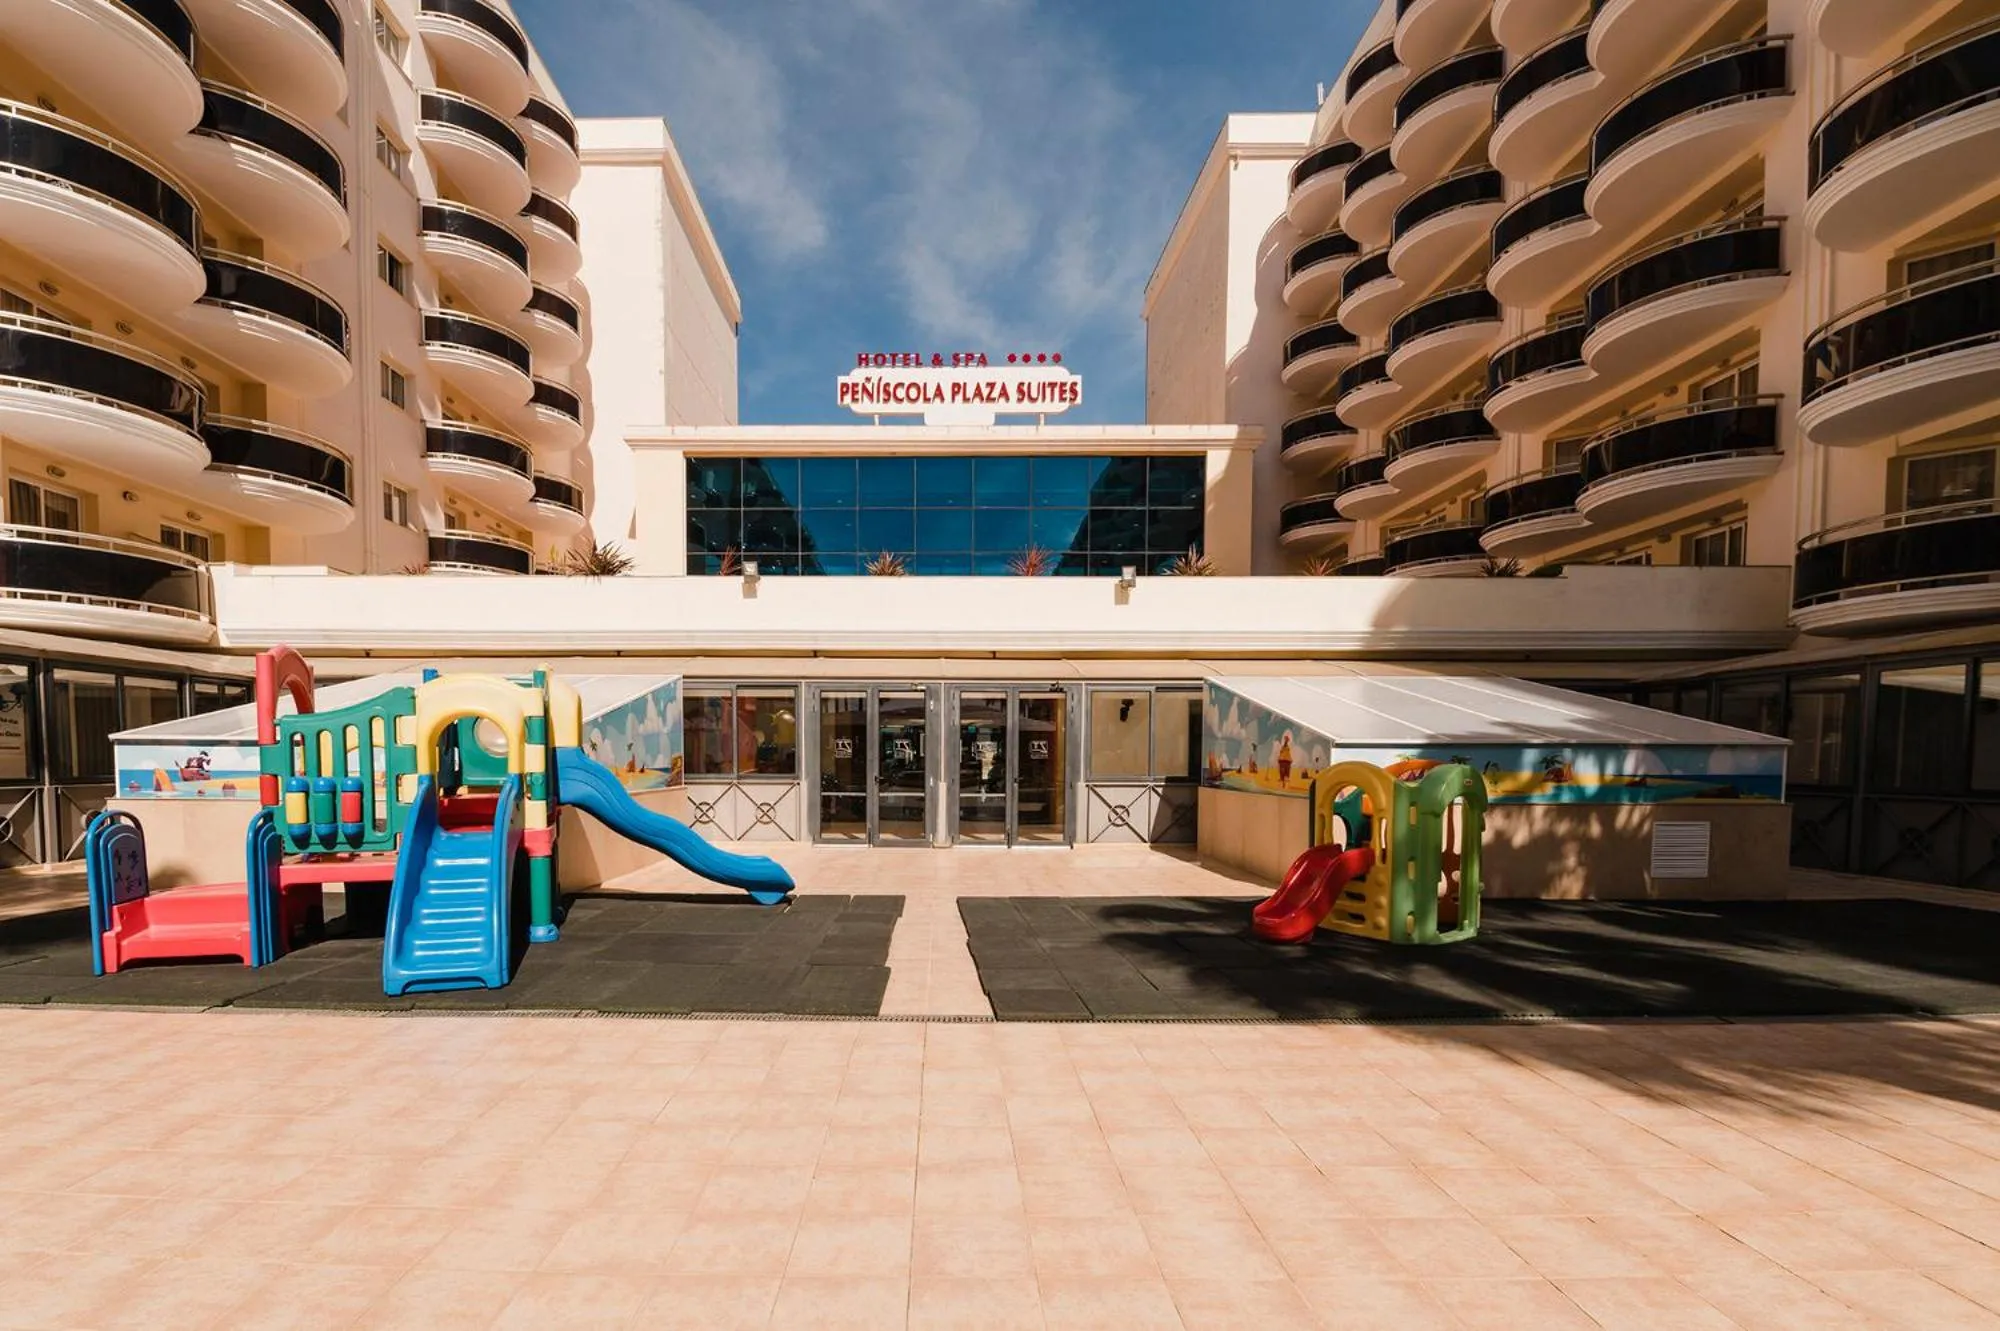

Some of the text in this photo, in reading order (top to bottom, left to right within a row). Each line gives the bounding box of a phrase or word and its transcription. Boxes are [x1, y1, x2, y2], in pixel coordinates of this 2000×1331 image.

[857, 353, 988, 367] HOTEL & SPA
[840, 376, 1078, 404] PEÑÍSCOLA PLAZA SUITES
